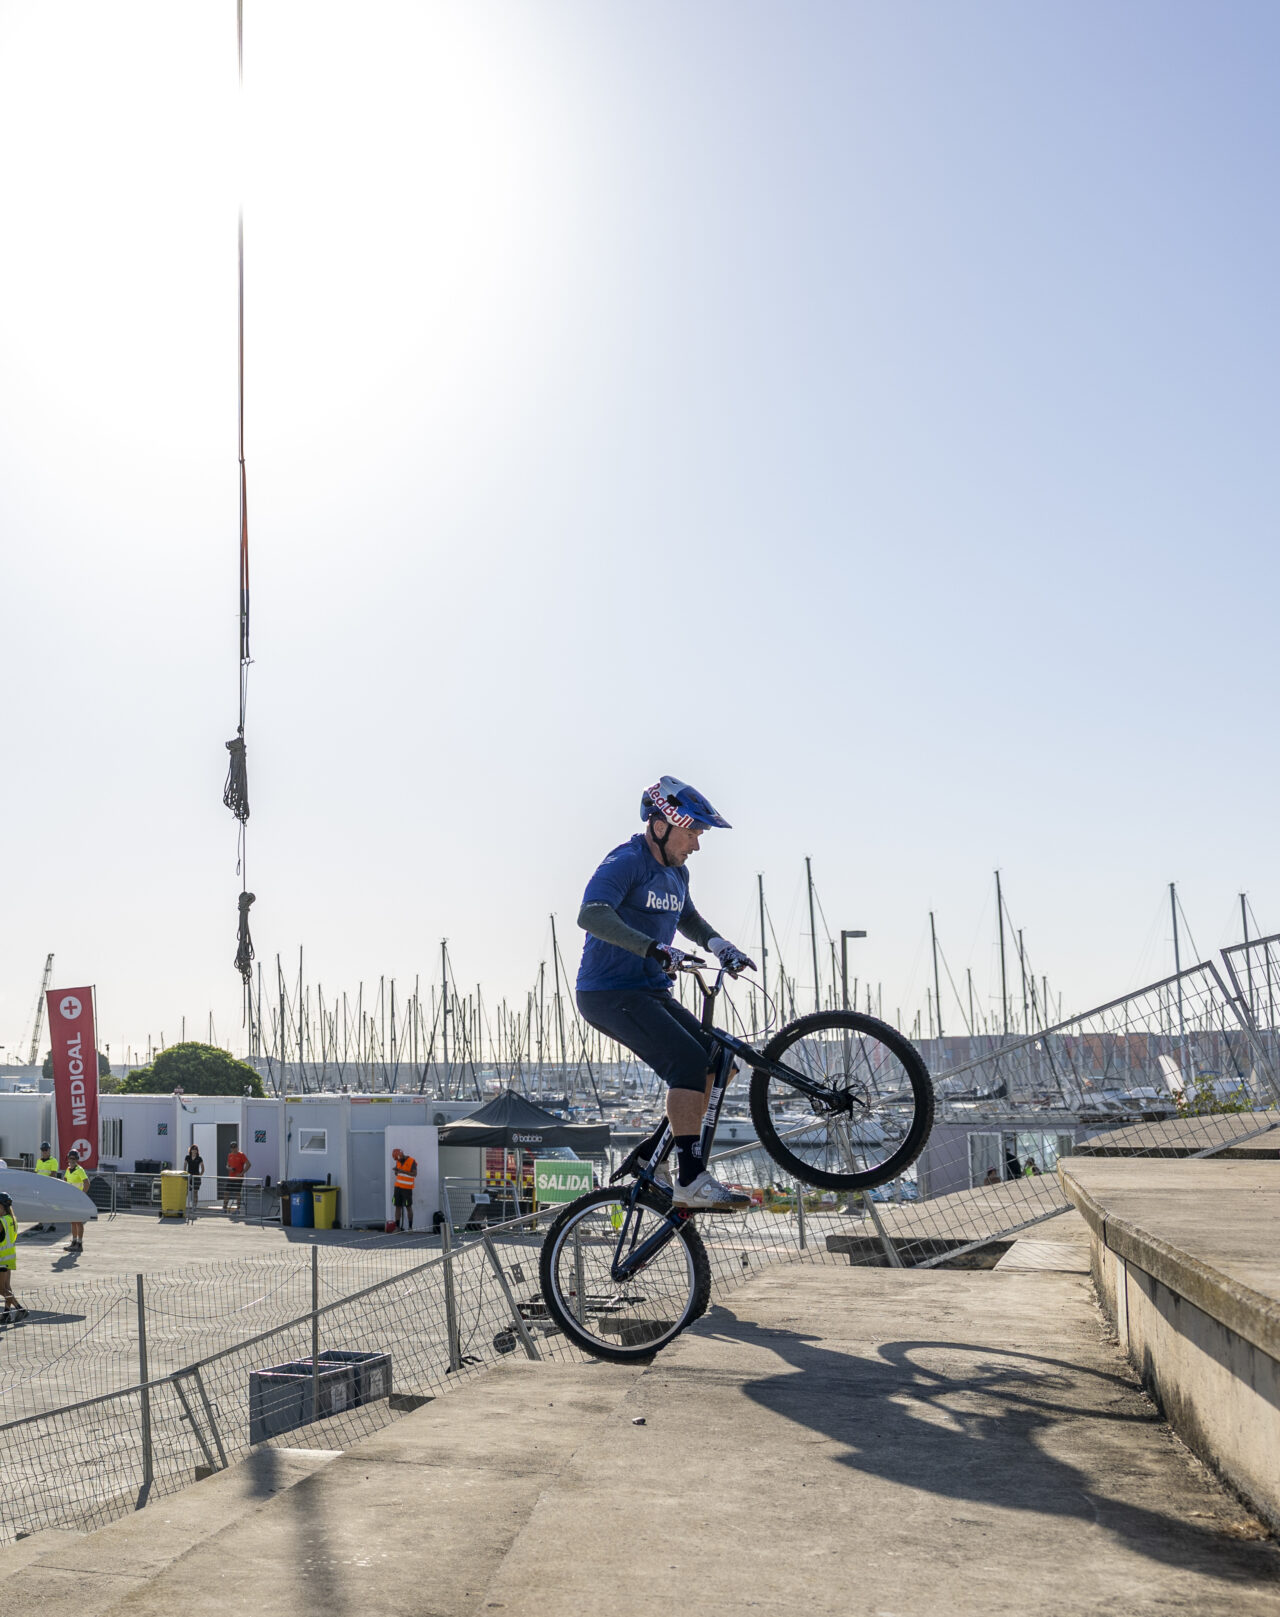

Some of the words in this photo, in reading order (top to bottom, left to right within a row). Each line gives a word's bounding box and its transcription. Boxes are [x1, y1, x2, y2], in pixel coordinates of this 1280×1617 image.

[647, 782, 667, 808] Red
[662, 804, 694, 828] Bull
[645, 890, 669, 911] Red
[66, 1031, 88, 1126] MEDICAL
[538, 1173, 590, 1191] SALIDA
